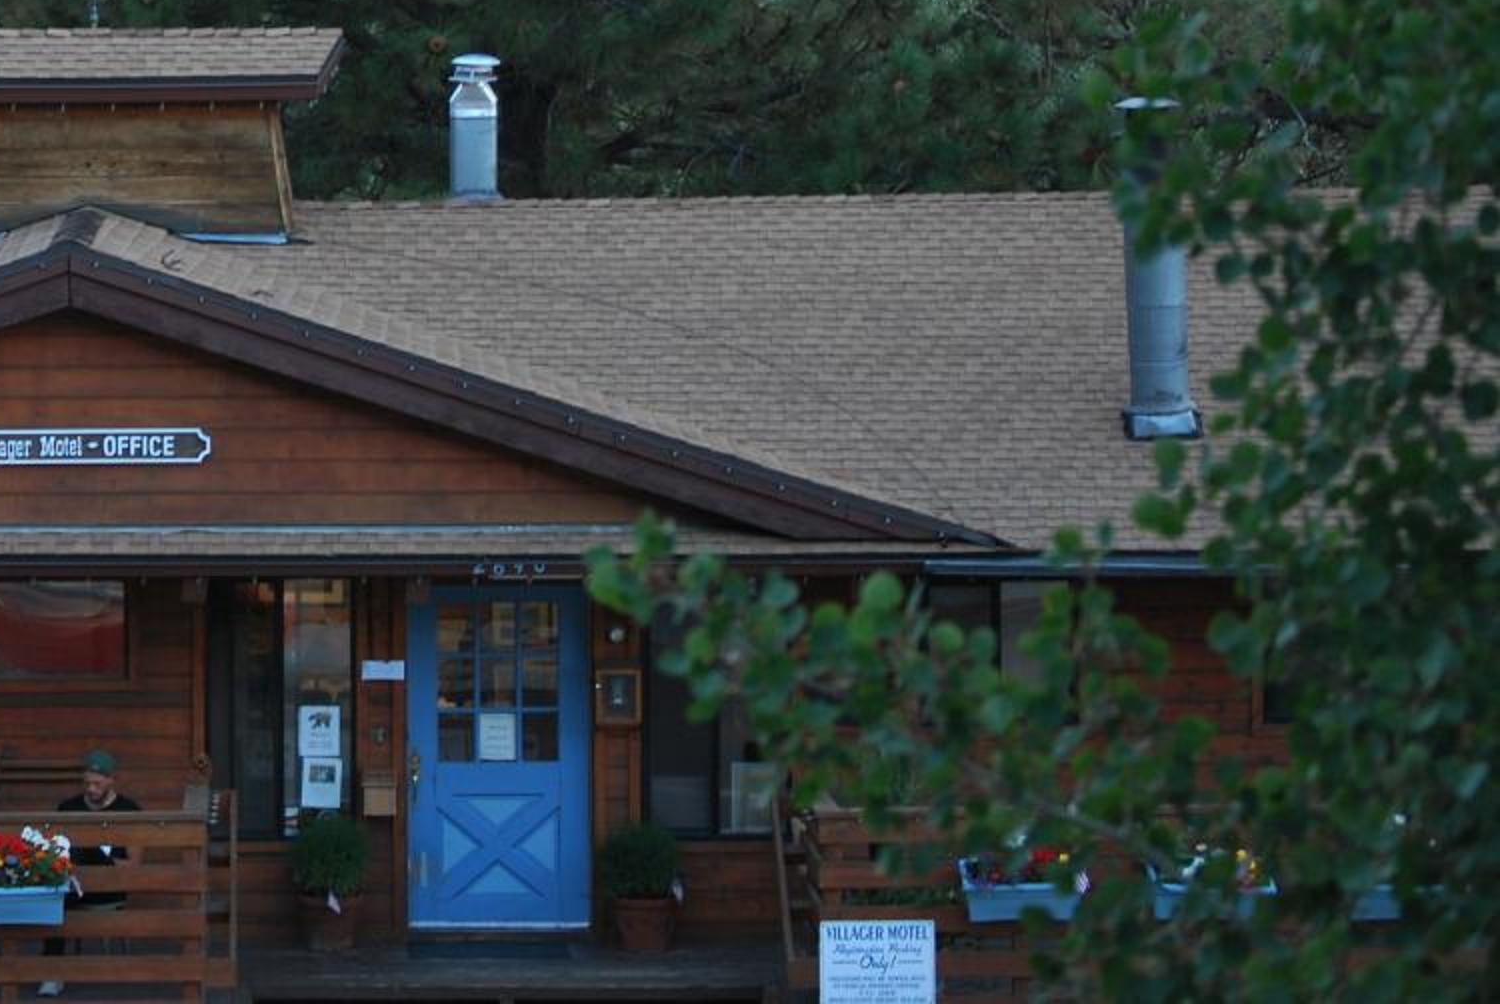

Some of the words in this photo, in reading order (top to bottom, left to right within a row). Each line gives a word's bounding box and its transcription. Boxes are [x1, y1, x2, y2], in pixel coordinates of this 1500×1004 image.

[40, 436, 83, 458] Motel
[103, 435, 175, 457] OFFICE
[826, 924, 884, 941] VILLAGER
[887, 924, 928, 941] MOTEL
[860, 953, 898, 974] Only!
